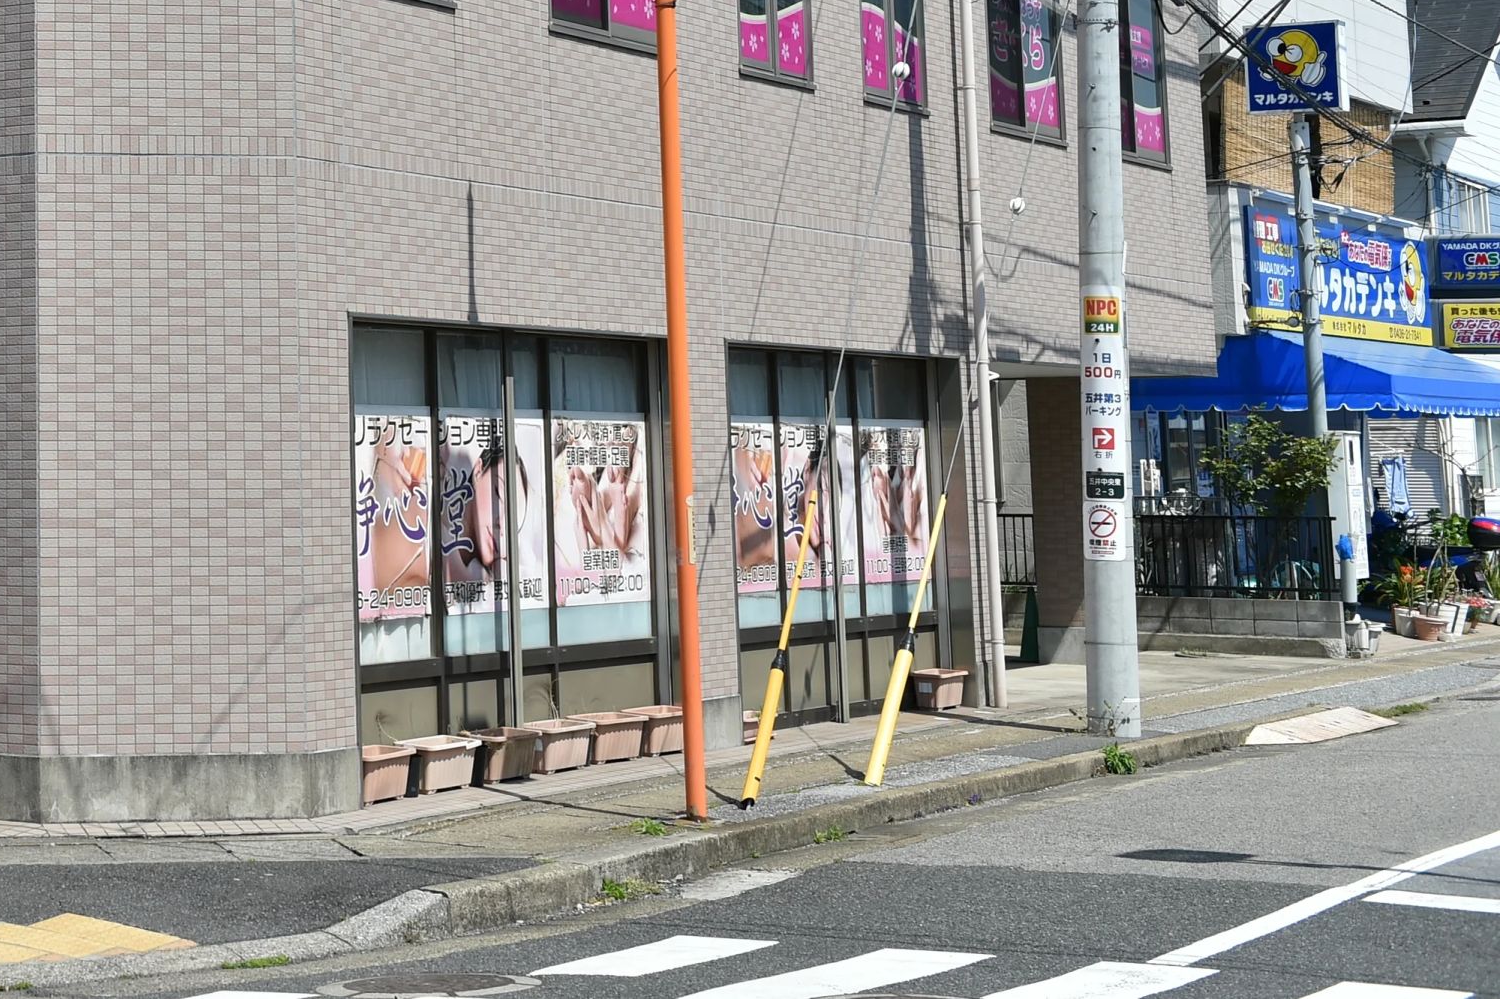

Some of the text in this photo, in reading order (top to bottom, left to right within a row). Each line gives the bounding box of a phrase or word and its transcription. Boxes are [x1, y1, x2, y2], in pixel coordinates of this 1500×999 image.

[1254, 91, 1334, 105] マルタカンキ
[1442, 242, 1478, 251] YAMADA
[1464, 252, 1500, 267] CMS
[1316, 265, 1397, 319] ルタカデンキ
[1086, 300, 1117, 316] NPC
[1090, 323, 1114, 332] 24H
[1085, 367, 1121, 379] 500円
[1085, 393, 1121, 403] 五井第3
[1085, 406, 1121, 416] パーキング
[1095, 488, 1114, 496] 2-3
